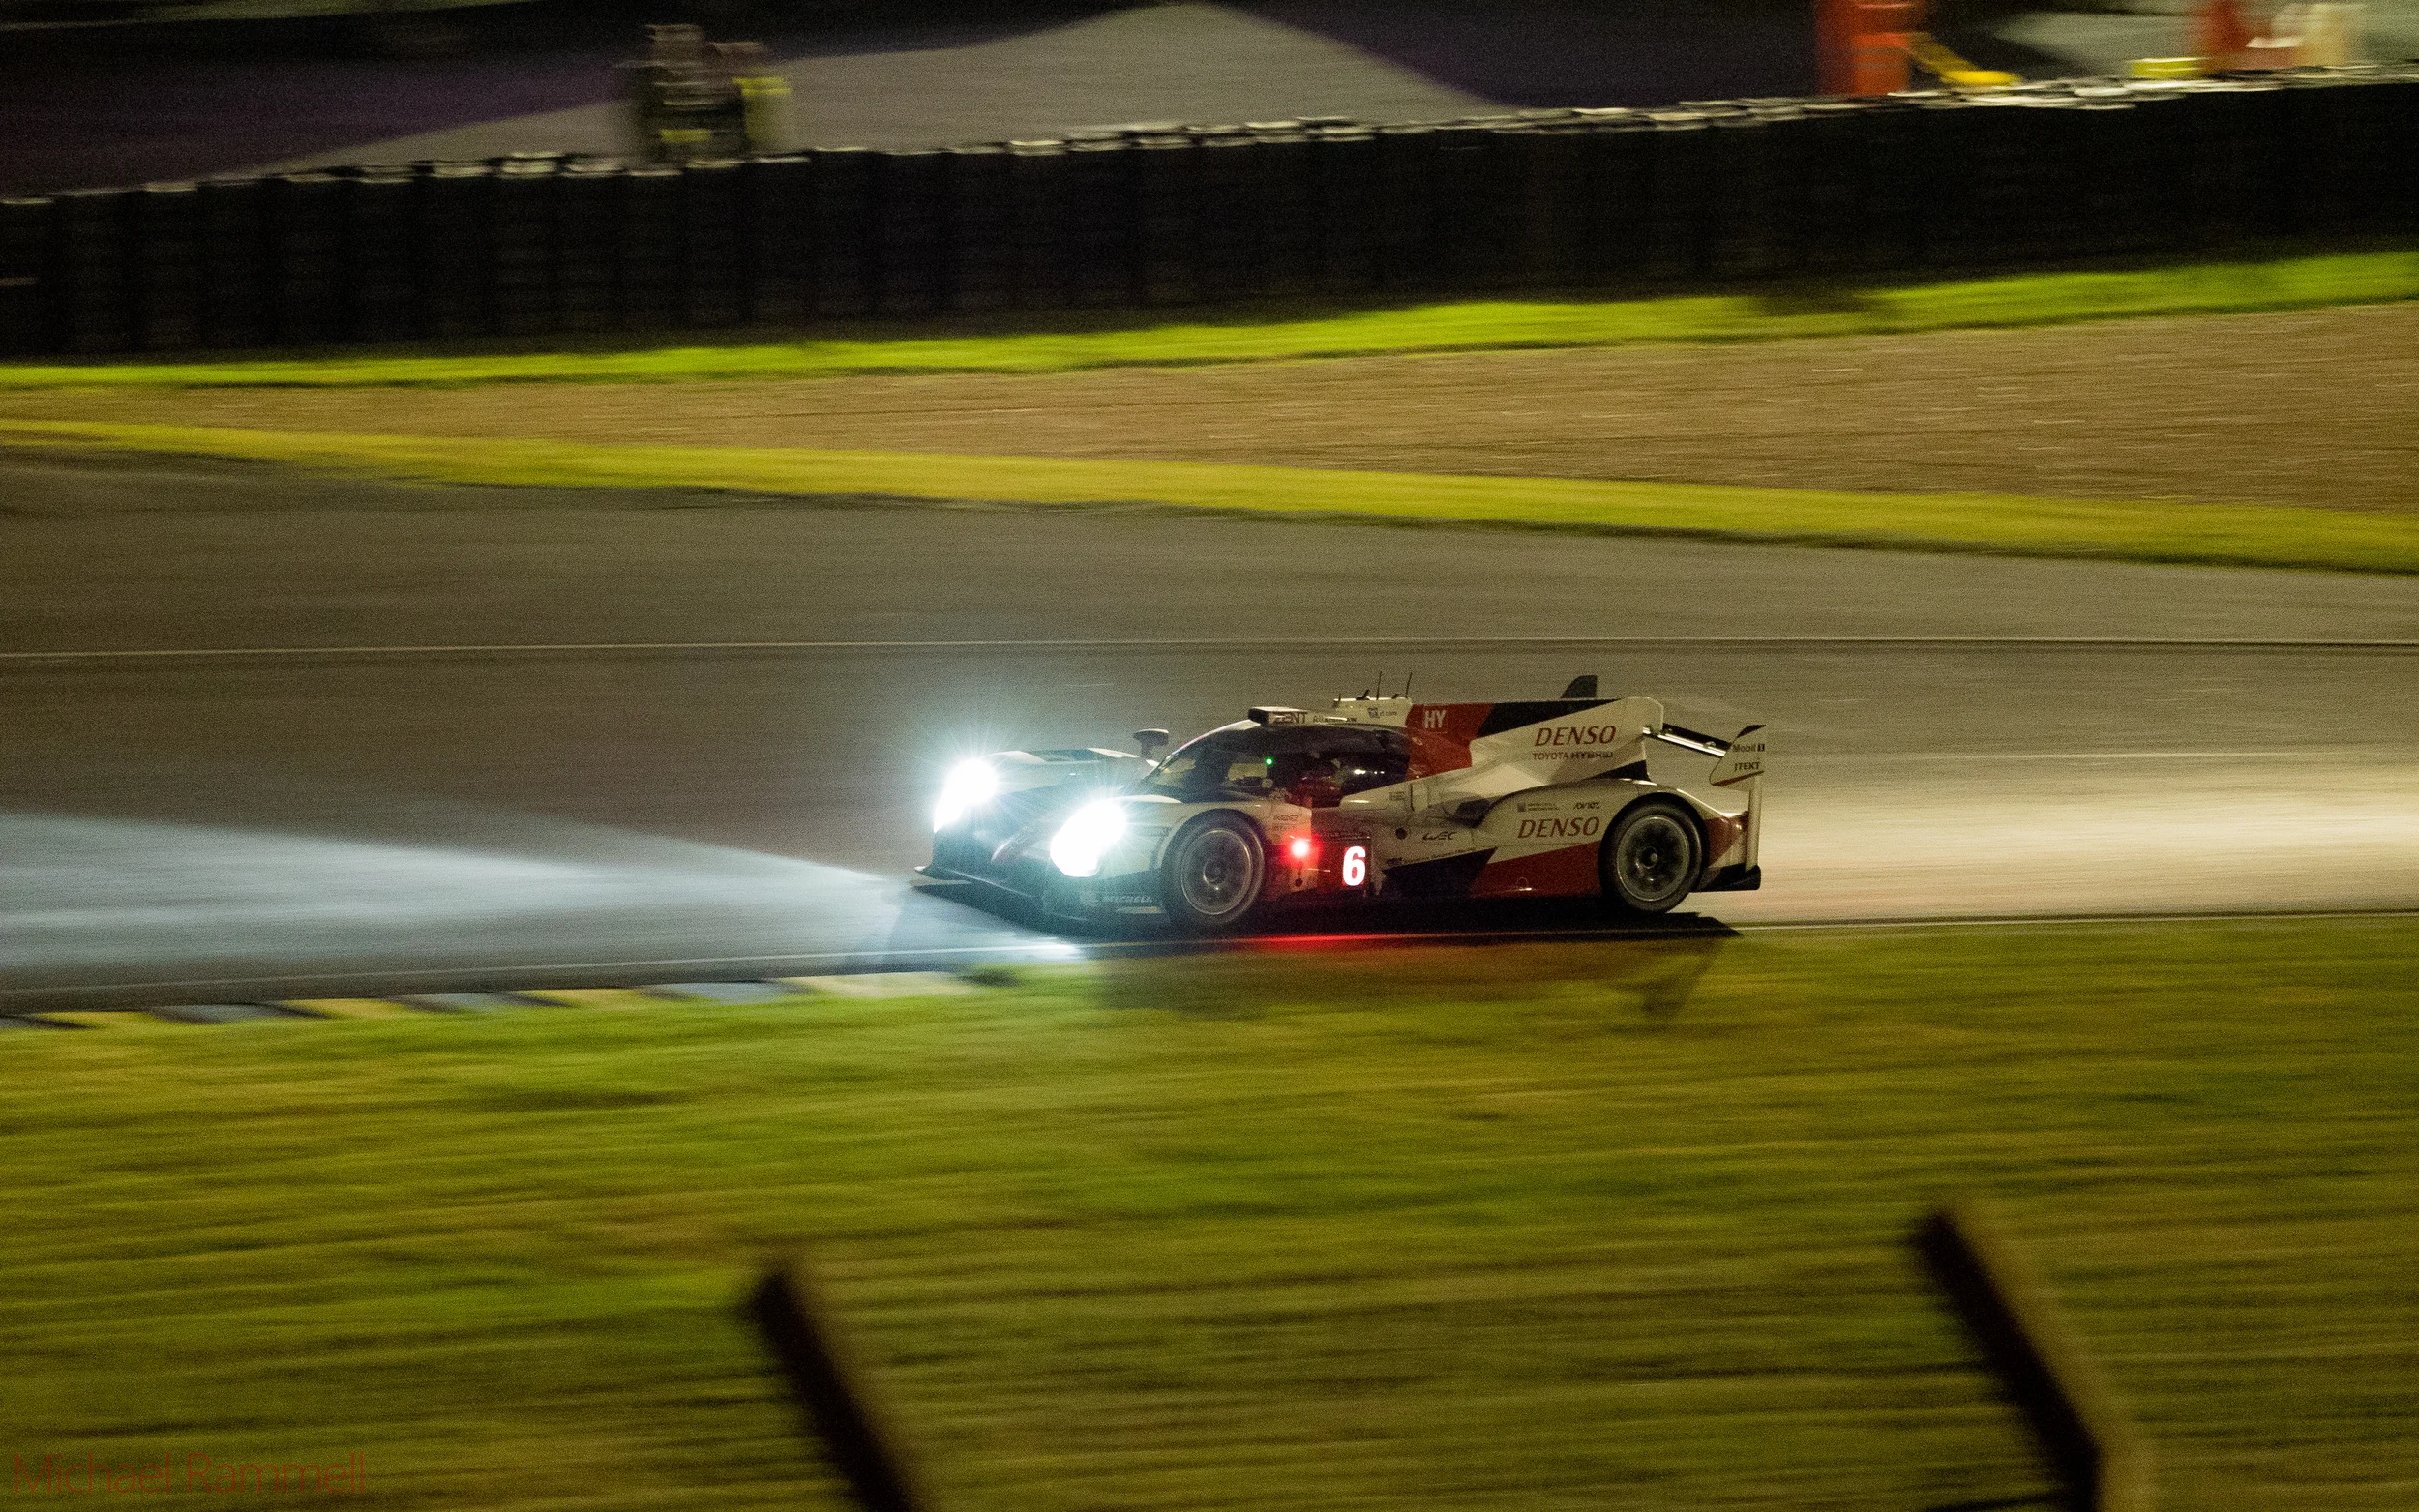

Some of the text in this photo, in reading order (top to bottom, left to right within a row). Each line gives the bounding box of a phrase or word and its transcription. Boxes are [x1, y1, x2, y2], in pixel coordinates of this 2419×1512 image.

[1424, 710, 1447, 728] HY
[1534, 726, 1617, 747] DENSO
[1532, 752, 1568, 760] TOYOTA
[1517, 816, 1600, 839] DENSO
[1342, 845, 1367, 887] 6
